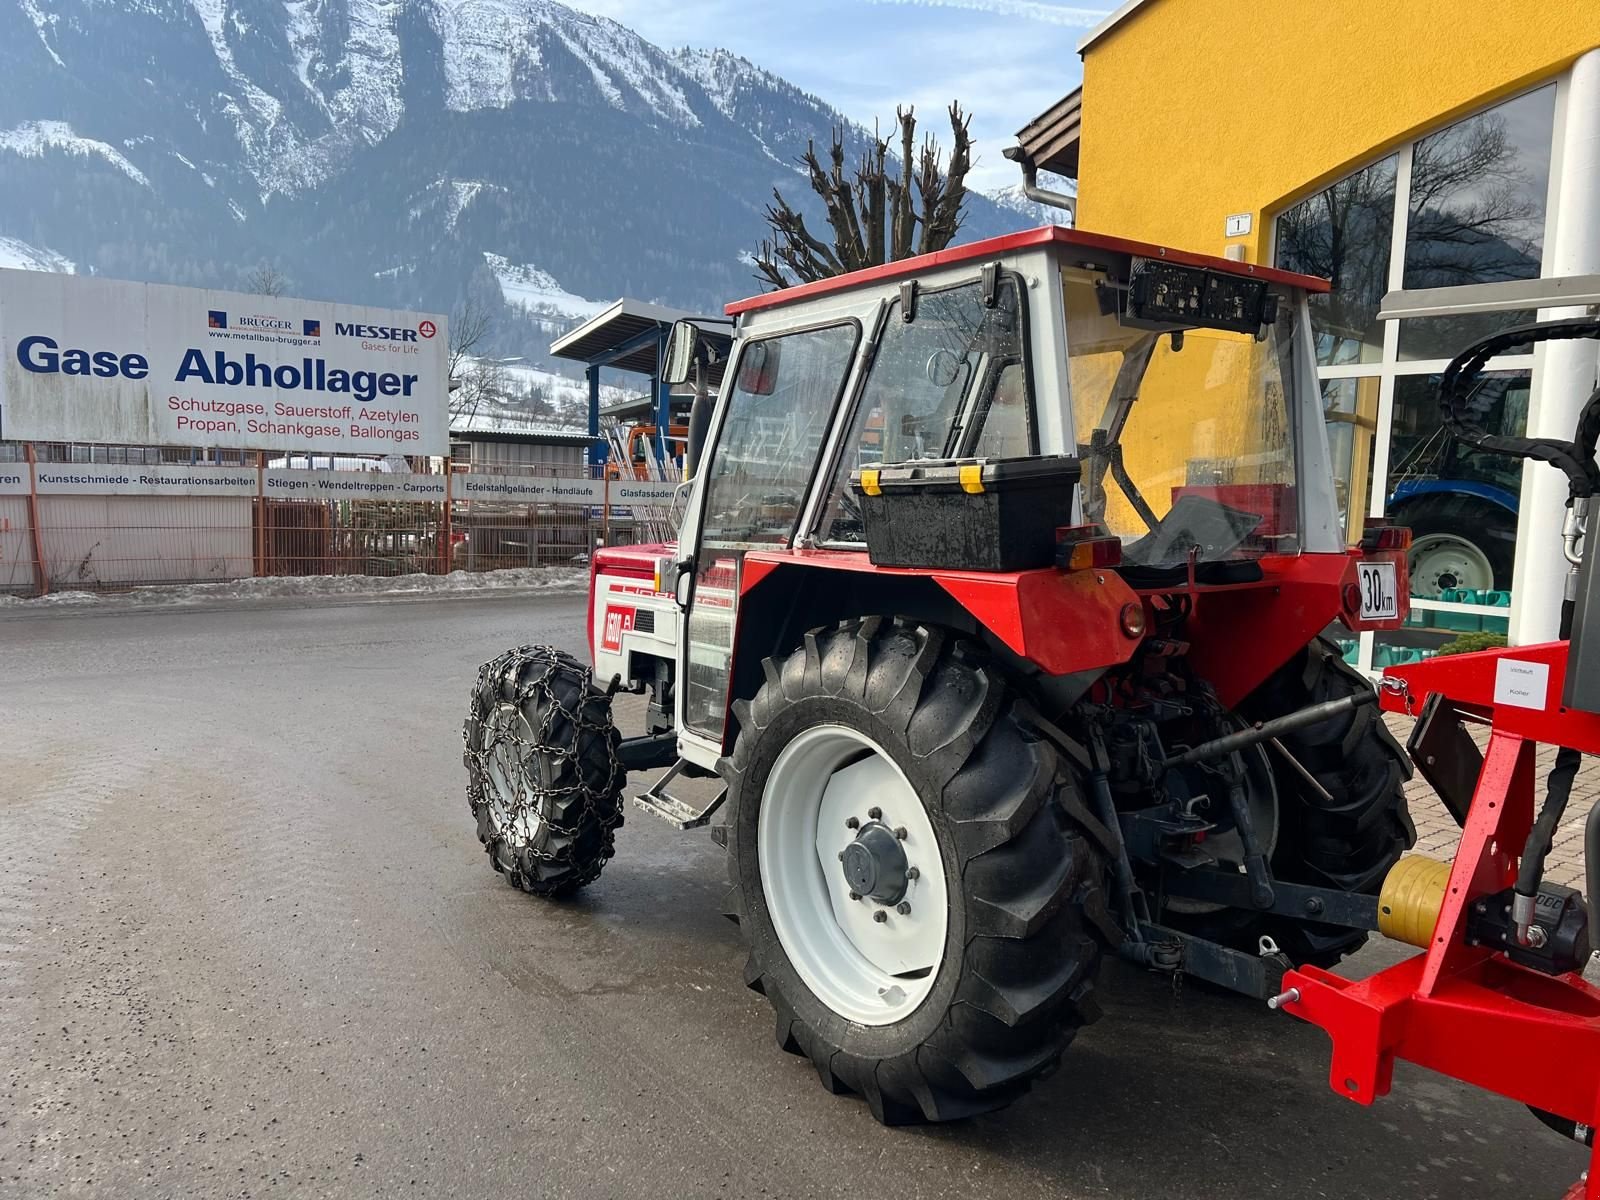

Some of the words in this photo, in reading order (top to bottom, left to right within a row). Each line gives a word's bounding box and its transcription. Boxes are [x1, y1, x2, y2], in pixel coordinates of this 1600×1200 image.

[208, 331, 321, 346] www.metallbau-brugger.at
[335, 323, 418, 342] MESSER
[361, 341, 386, 352] Gases
[388, 343, 401, 353] for
[403, 343, 419, 354] Life
[16, 335, 149, 380] Gase
[174, 348, 419, 402] Abhollager
[168, 396, 269, 417] Schutzgase,
[274, 402, 355, 421] Sauerstoff,
[358, 407, 419, 424] Azetylen
[177, 416, 241, 434] Propan,
[247, 420, 345, 439] Schankgase,
[350, 425, 420, 442] Ballongas
[39, 474, 129, 485] Kunstschmiede
[139, 475, 256, 486] Restaurationsarbeiten
[267, 479, 309, 490] Stiegen
[318, 480, 394, 493] Wendeltreppen
[403, 483, 445, 494] Carports
[466, 483, 544, 496] Edelstahlgeländer
[552, 486, 593, 497] Handläufe
[620, 488, 675, 498] Glasfassaden
[1363, 569, 1381, 612] 30
[1382, 592, 1393, 611] km
[624, 614, 631, 631] A
